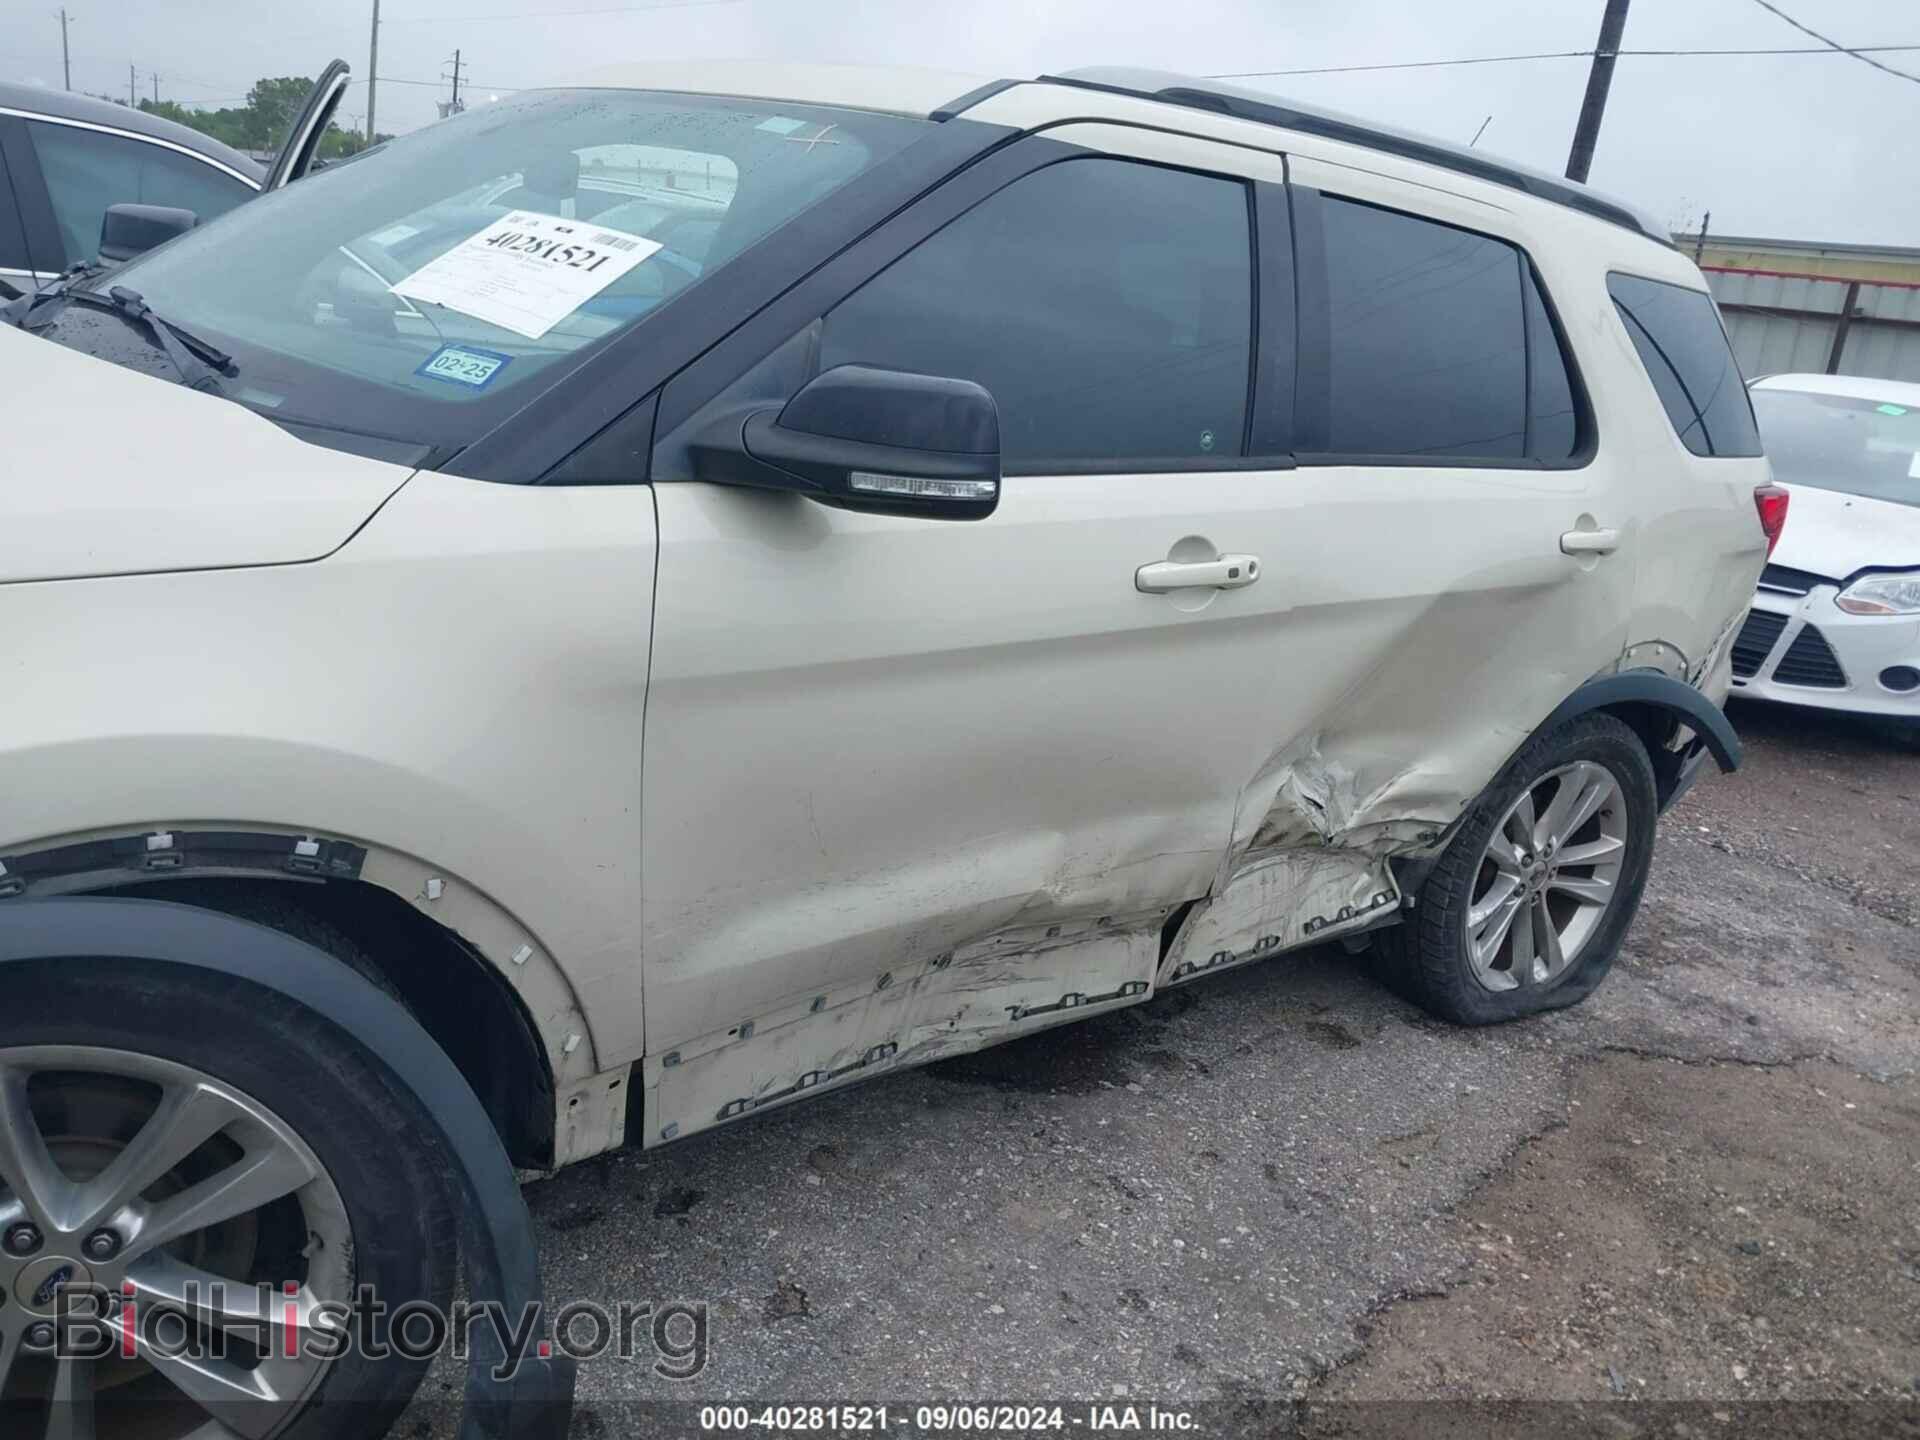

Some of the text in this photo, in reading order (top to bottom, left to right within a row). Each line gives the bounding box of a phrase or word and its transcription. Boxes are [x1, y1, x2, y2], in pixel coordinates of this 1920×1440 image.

[486, 231, 611, 272] 40281521
[434, 356, 491, 378] 02 25
